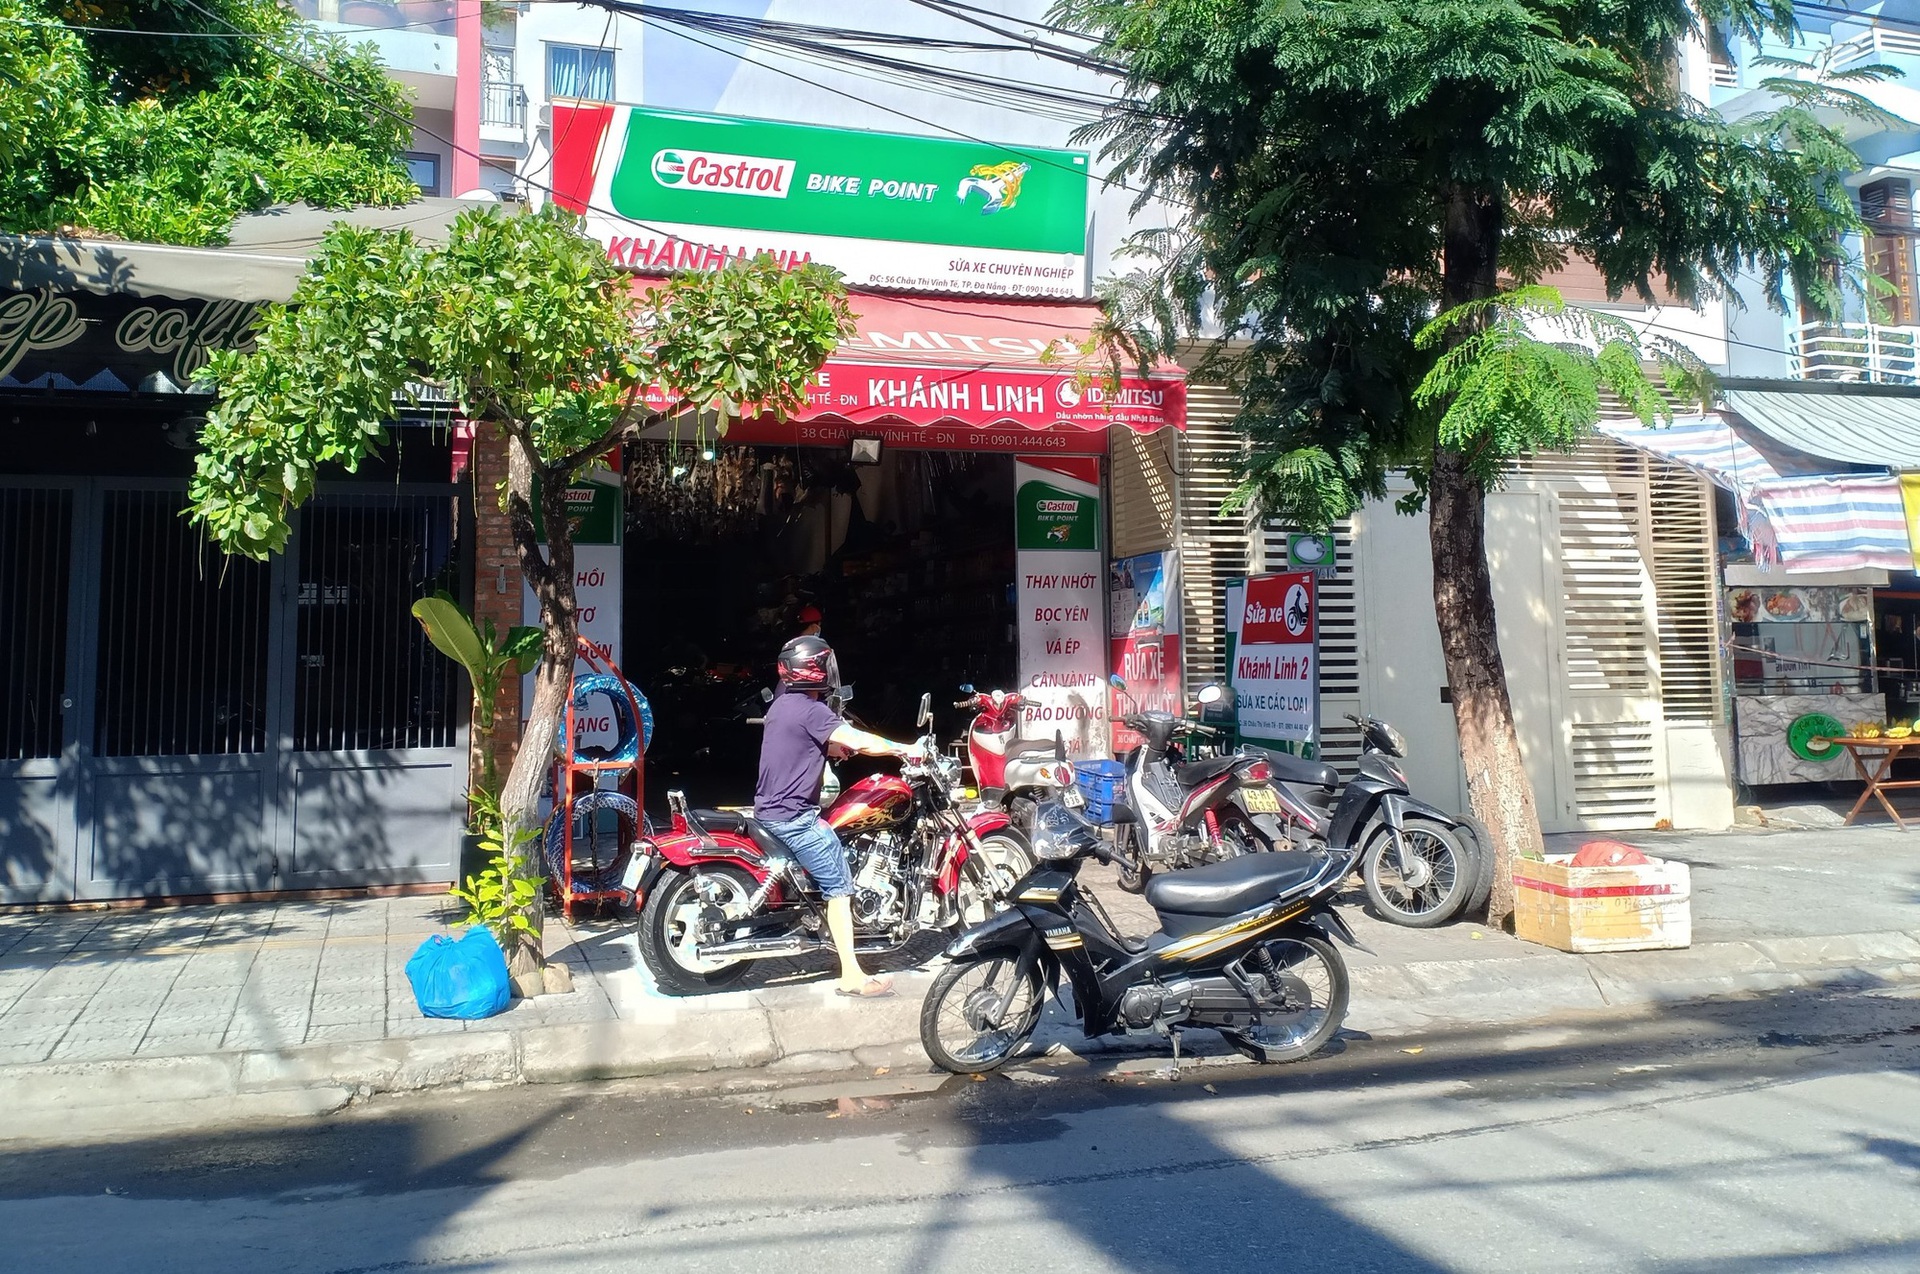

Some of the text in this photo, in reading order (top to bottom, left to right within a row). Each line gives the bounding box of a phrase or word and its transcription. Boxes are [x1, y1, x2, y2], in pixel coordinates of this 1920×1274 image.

[687, 156, 784, 192] Castrol
[806, 173, 939, 203] BIKE POINT
[607, 235, 730, 272] KHÁNH
[949, 257, 1074, 282] SỬA XE CHUYÊN NGHIỆP
[917, 277, 930, 288] Thị
[962, 280, 973, 289] TP.
[1012, 283, 1025, 293] ĐT:
[1025, 285, 1044, 294] 0901
[1044, 287, 1059, 295] 444
[1060, 288, 1074, 296] 643
[840, 394, 859, 406] ĐN
[868, 375, 1045, 414] KHÁNH LINH
[801, 427, 816, 439] 38
[880, 430, 910, 443] VĨNH
[912, 430, 927, 443] TẾ
[936, 433, 955, 444] ĐN
[969, 433, 990, 446] ĐT:
[991, 434, 1067, 449] 0901.444.643
[567, 505, 595, 513] POINT
[1047, 501, 1076, 512] Castrol
[576, 567, 605, 587] HỒI
[1025, 572, 1097, 589] THAY NHỚT
[1035, 605, 1089, 626] BỌC YÊN
[1245, 601, 1282, 624] Sửa xe
[1046, 636, 1081, 654] VÁ ÉP
[1238, 656, 1309, 680] Khánh Linh 2
[1031, 670, 1096, 688] CÂN VÀNH
[1255, 695, 1266, 710] XE
[1267, 692, 1285, 711] CÁC
[1045, 926, 1072, 938] YAMAHA
